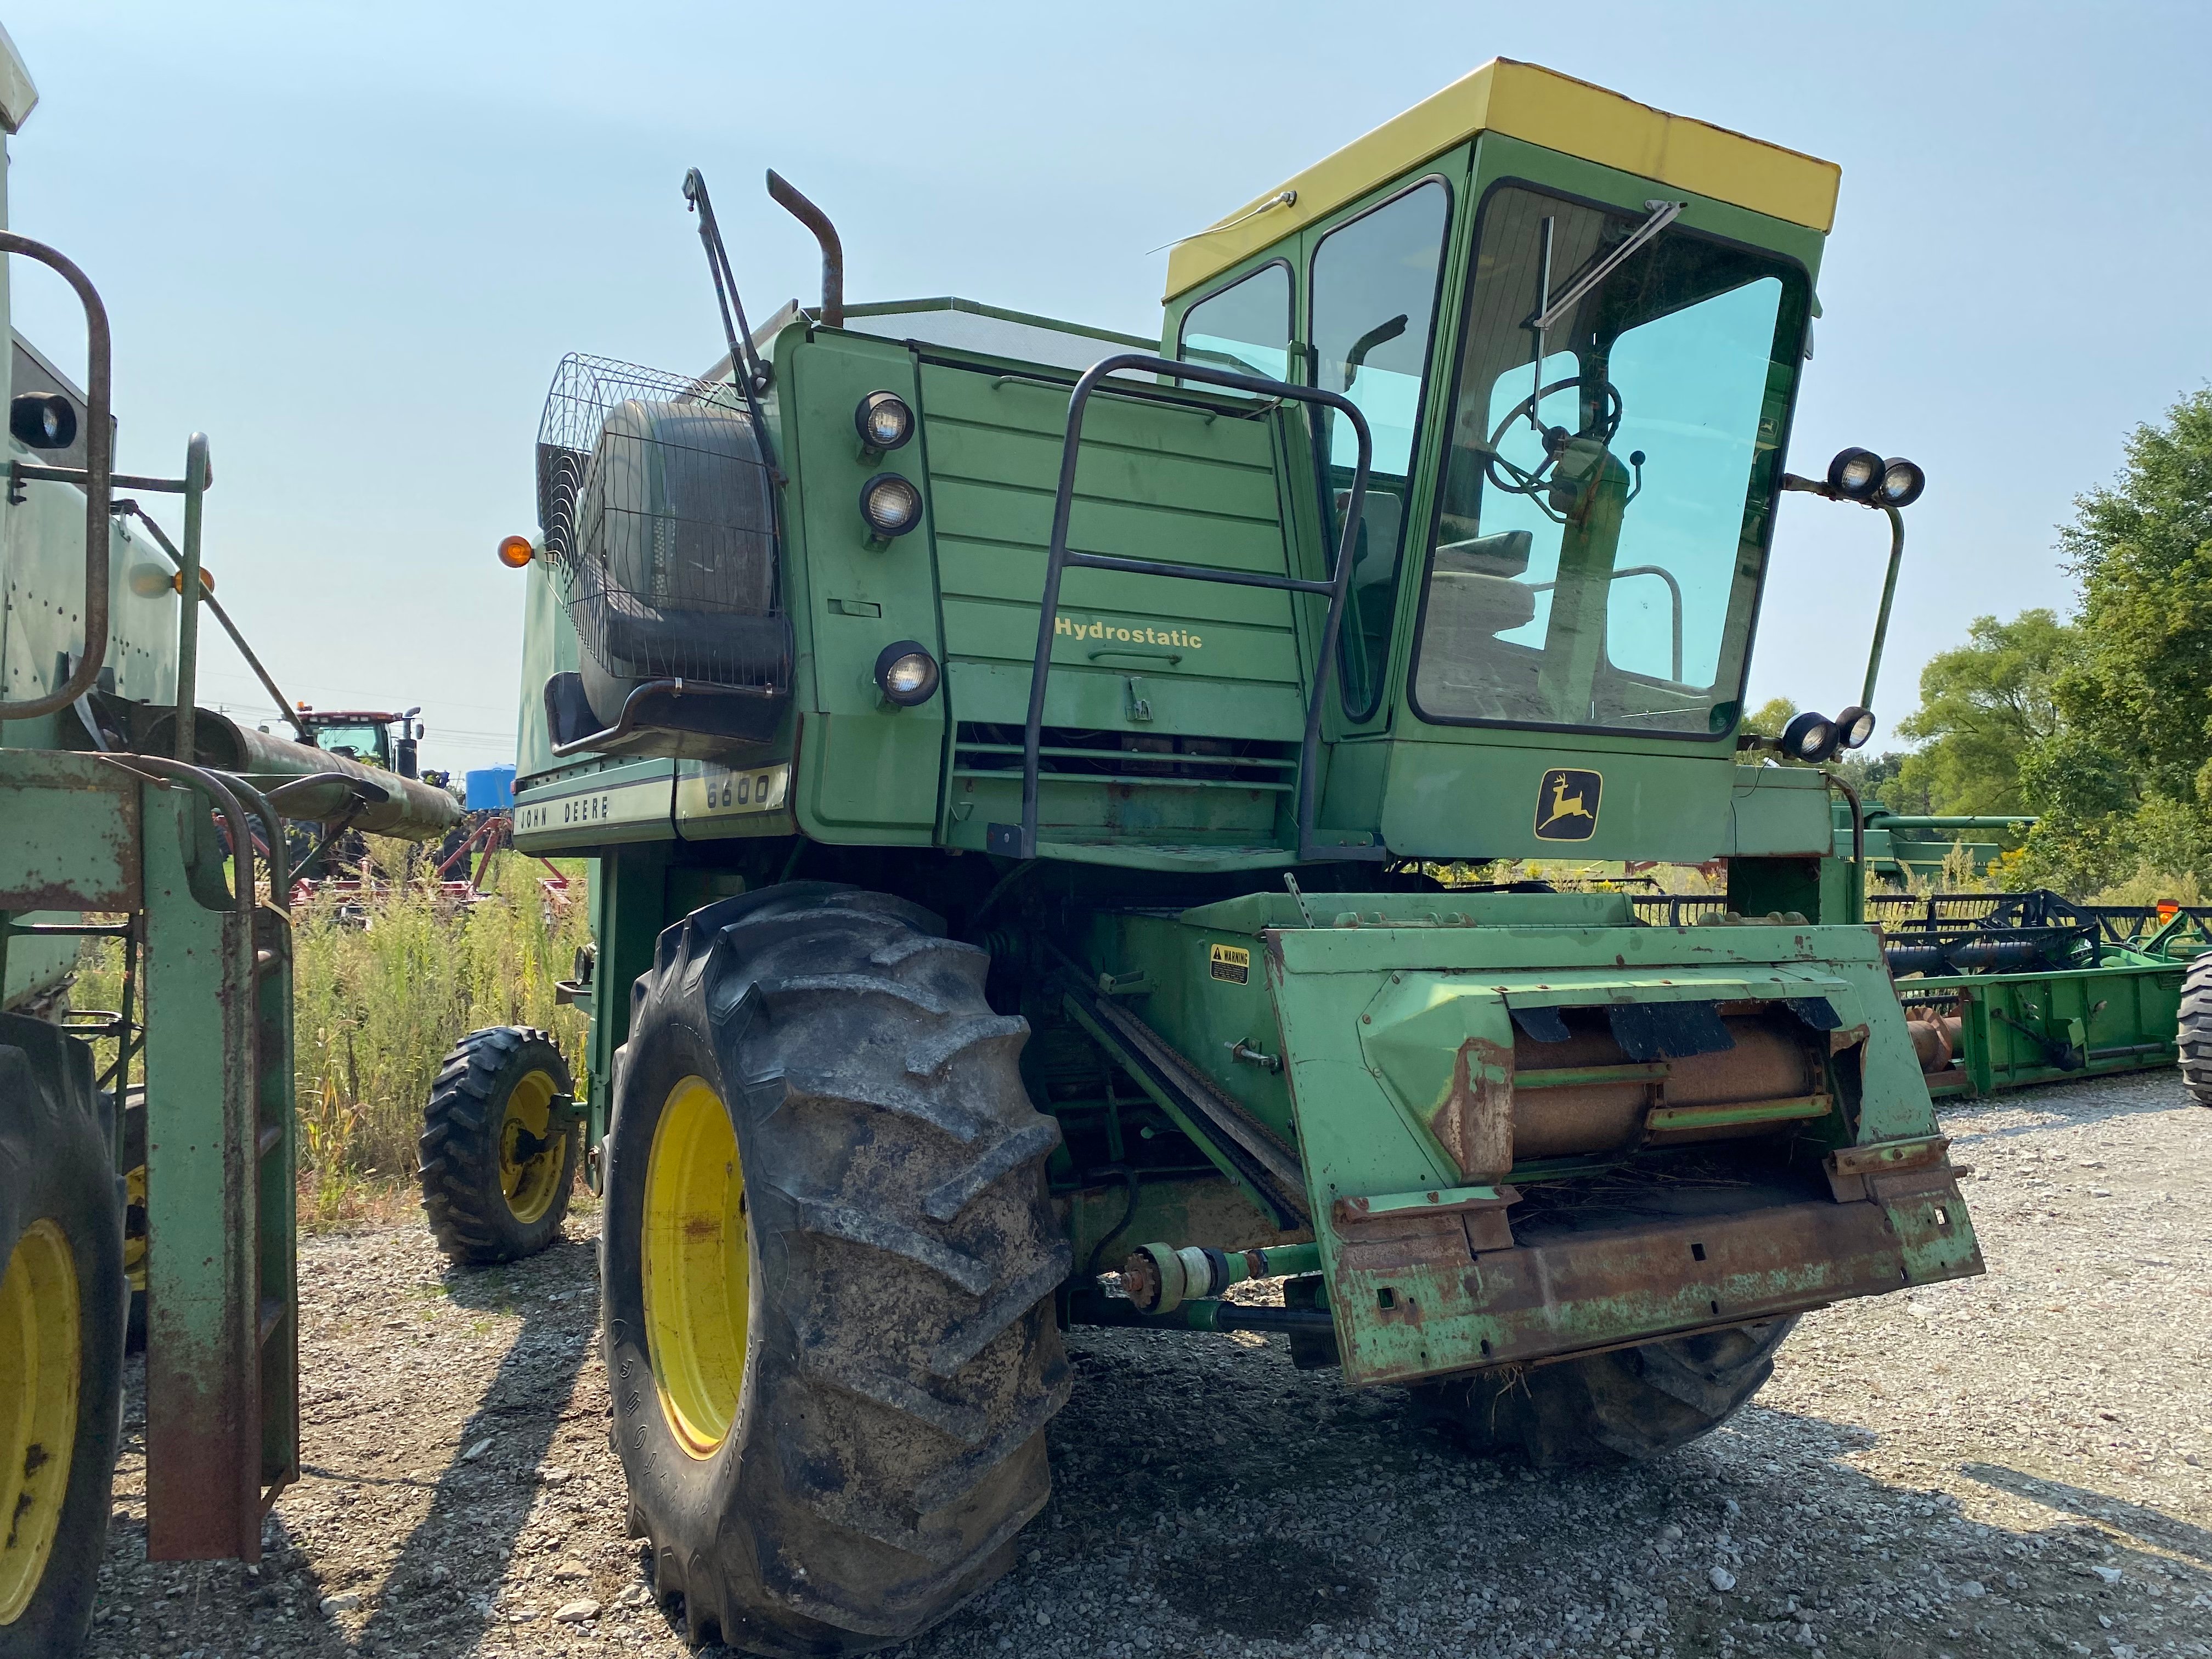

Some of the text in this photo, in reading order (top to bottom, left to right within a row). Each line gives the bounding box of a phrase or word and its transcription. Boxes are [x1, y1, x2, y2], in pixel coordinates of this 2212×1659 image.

[1054, 617, 1203, 649] Hydrostatic
[707, 775, 769, 809] 6600
[521, 796, 608, 829] JOHN DEERE
[1224, 950, 1248, 965] WARNING
